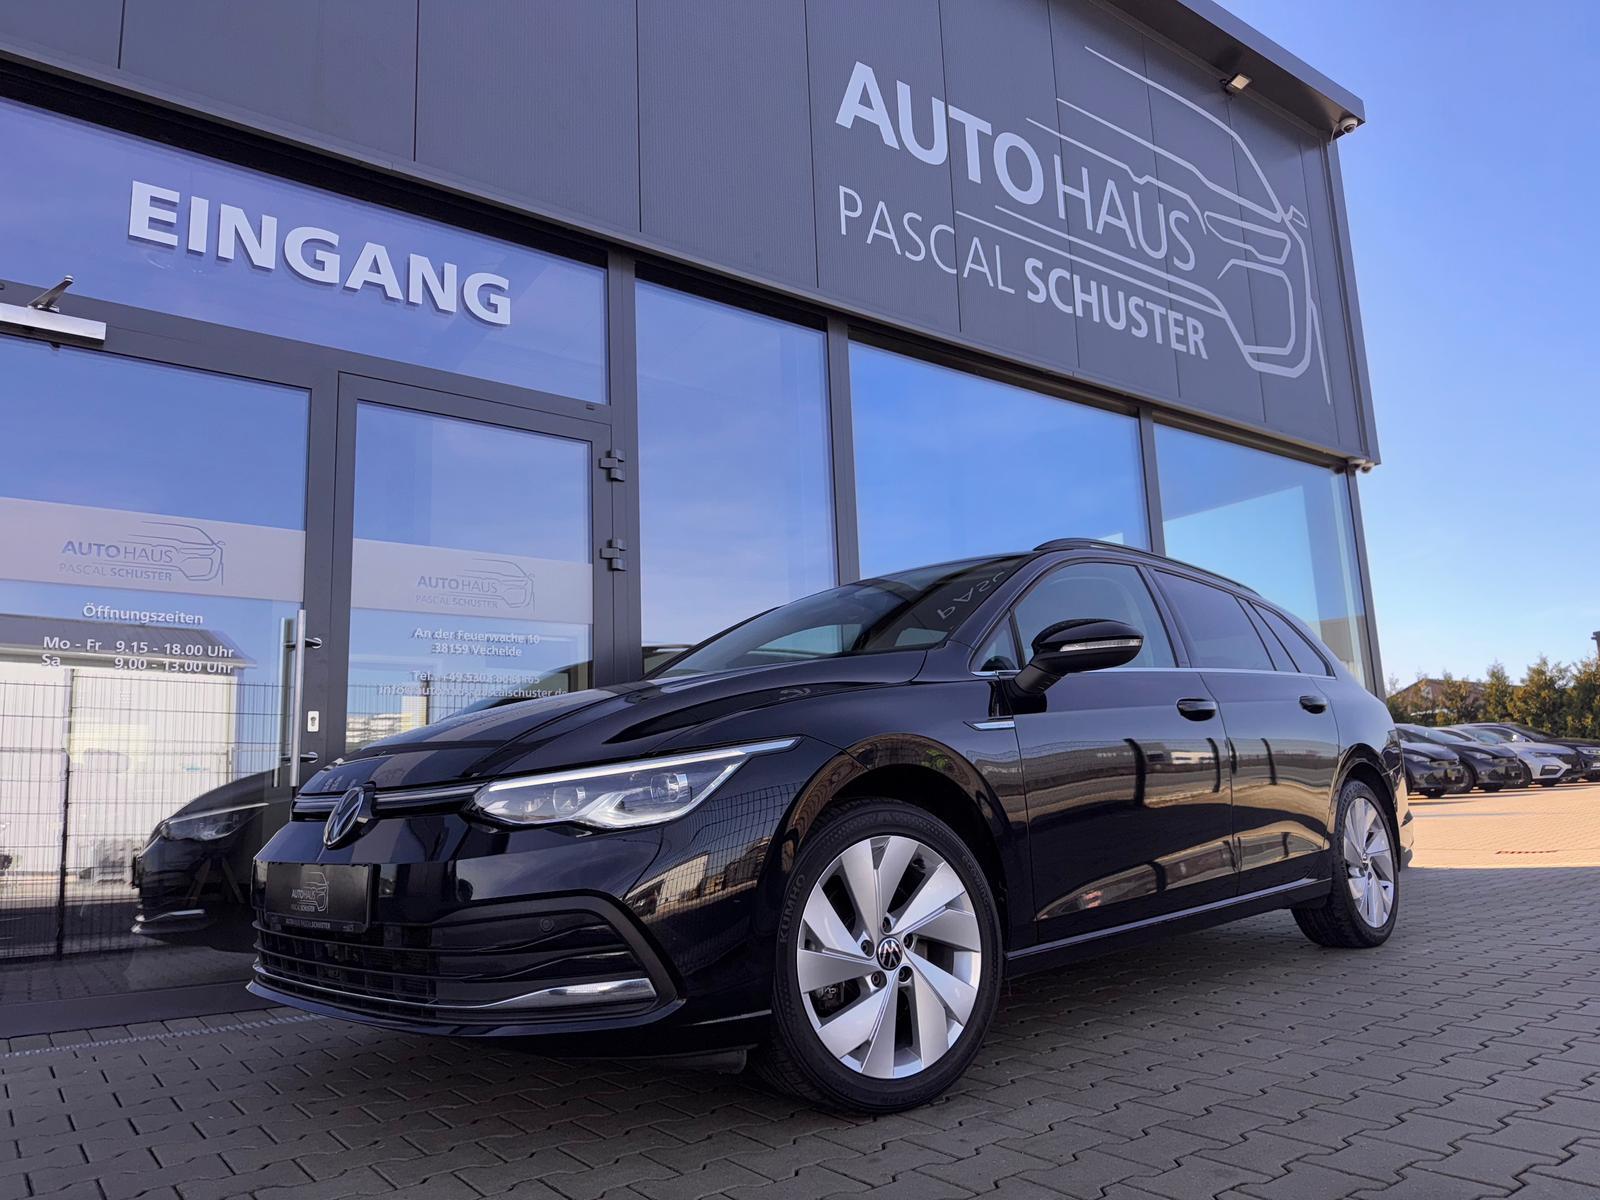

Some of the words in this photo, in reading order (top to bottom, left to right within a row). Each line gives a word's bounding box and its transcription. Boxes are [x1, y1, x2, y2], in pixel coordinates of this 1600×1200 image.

[128, 181, 511, 325] EINGANG
[839, 185, 1015, 294] PASCAL
[1024, 257, 1208, 360] SCHUSTER
[59, 563, 106, 576] PASCAL
[110, 567, 172, 582] SCHUSTER
[83, 602, 203, 625] Öffnungszeiten
[414, 627, 432, 639] An
[435, 628, 455, 640] der
[457, 630, 524, 643] Feuerwache
[43, 636, 71, 650] Mo
[86, 639, 102, 651] Fr
[116, 640, 148, 654] 9.15
[164, 643, 203, 656] 18.00
[207, 645, 234, 658] Uhr
[433, 642, 469, 654] 38159
[472, 644, 522, 657] Vechelde
[41, 654, 61, 667] Sa
[115, 657, 147, 670] 9.00
[163, 660, 201, 673] 13.00
[207, 662, 234, 675] Uhr
[779, 874, 806, 943] KUMHO
